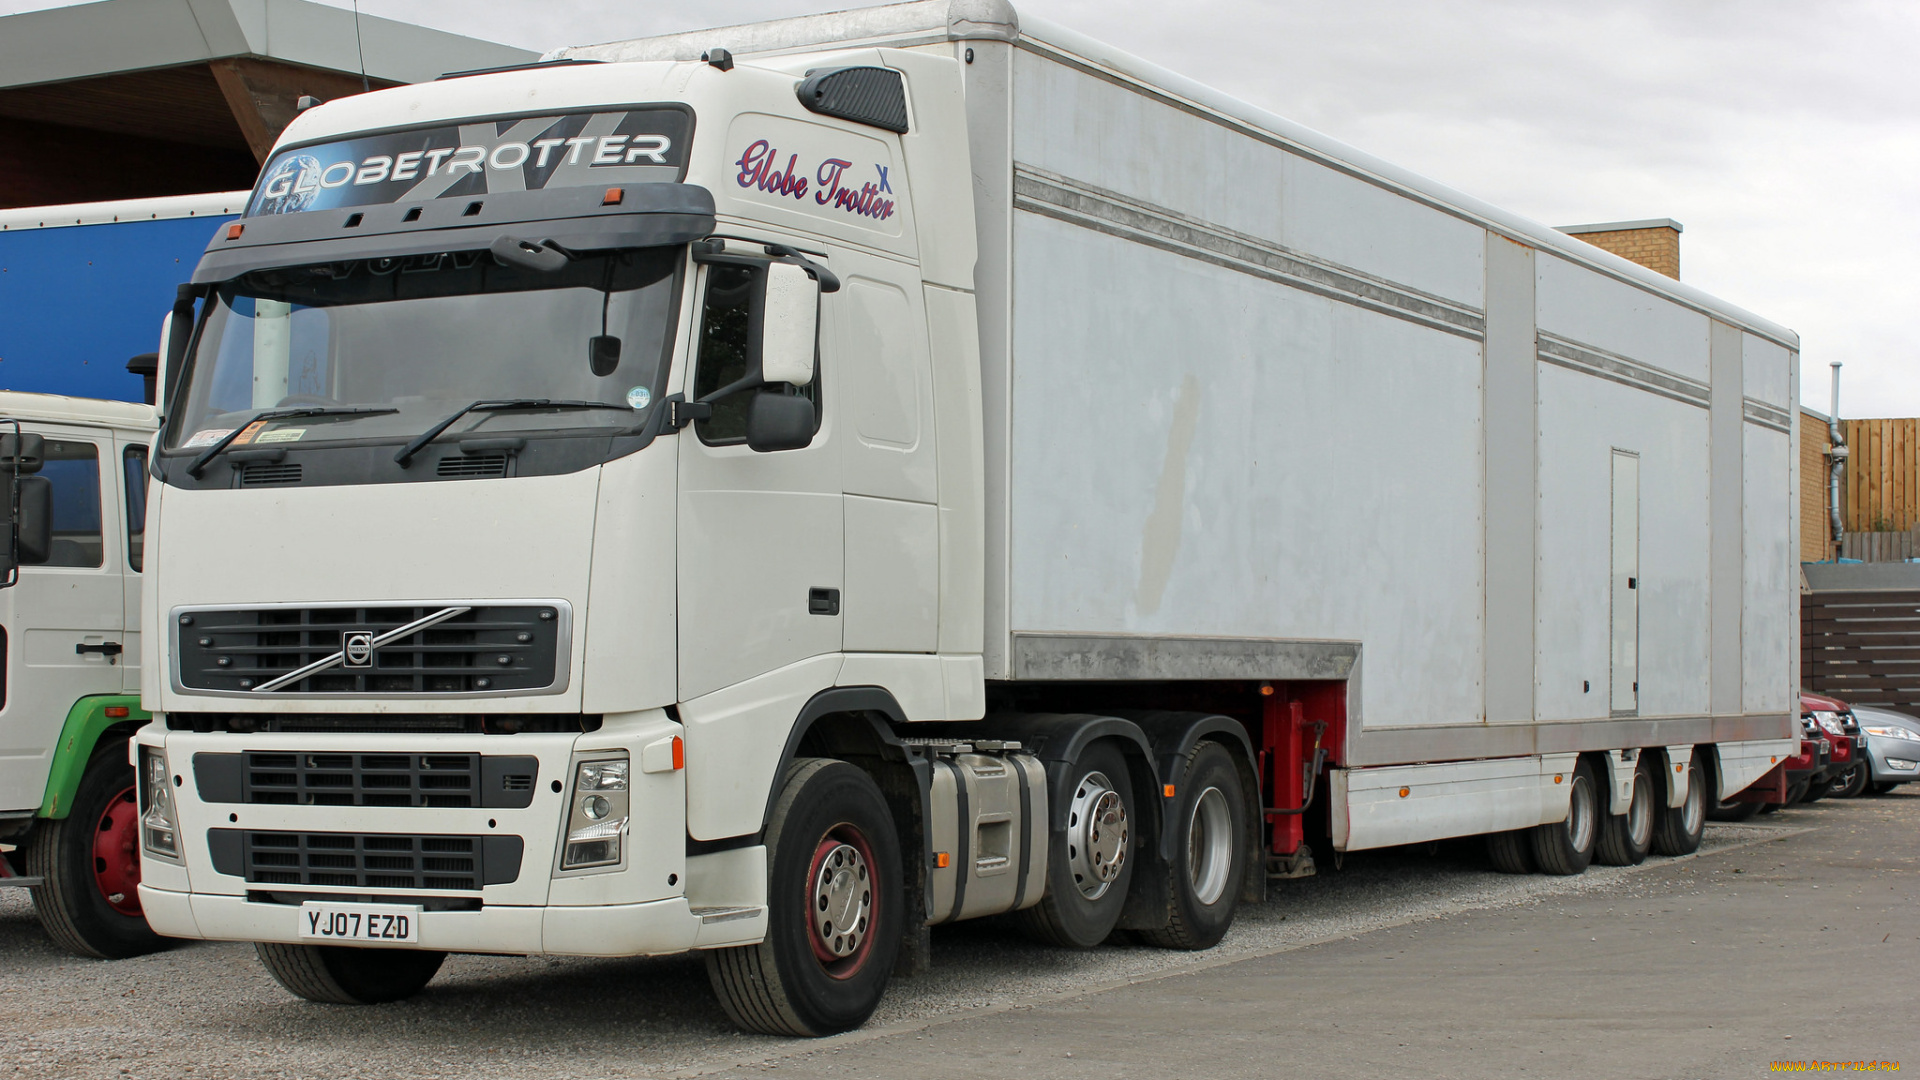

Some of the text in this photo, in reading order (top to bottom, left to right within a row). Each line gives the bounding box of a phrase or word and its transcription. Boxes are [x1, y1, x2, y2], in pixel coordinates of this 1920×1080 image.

[265, 133, 672, 200] GLOBETROTTER
[735, 139, 894, 221] Globe Trotter
[308, 911, 409, 939] YJ07 EZD
